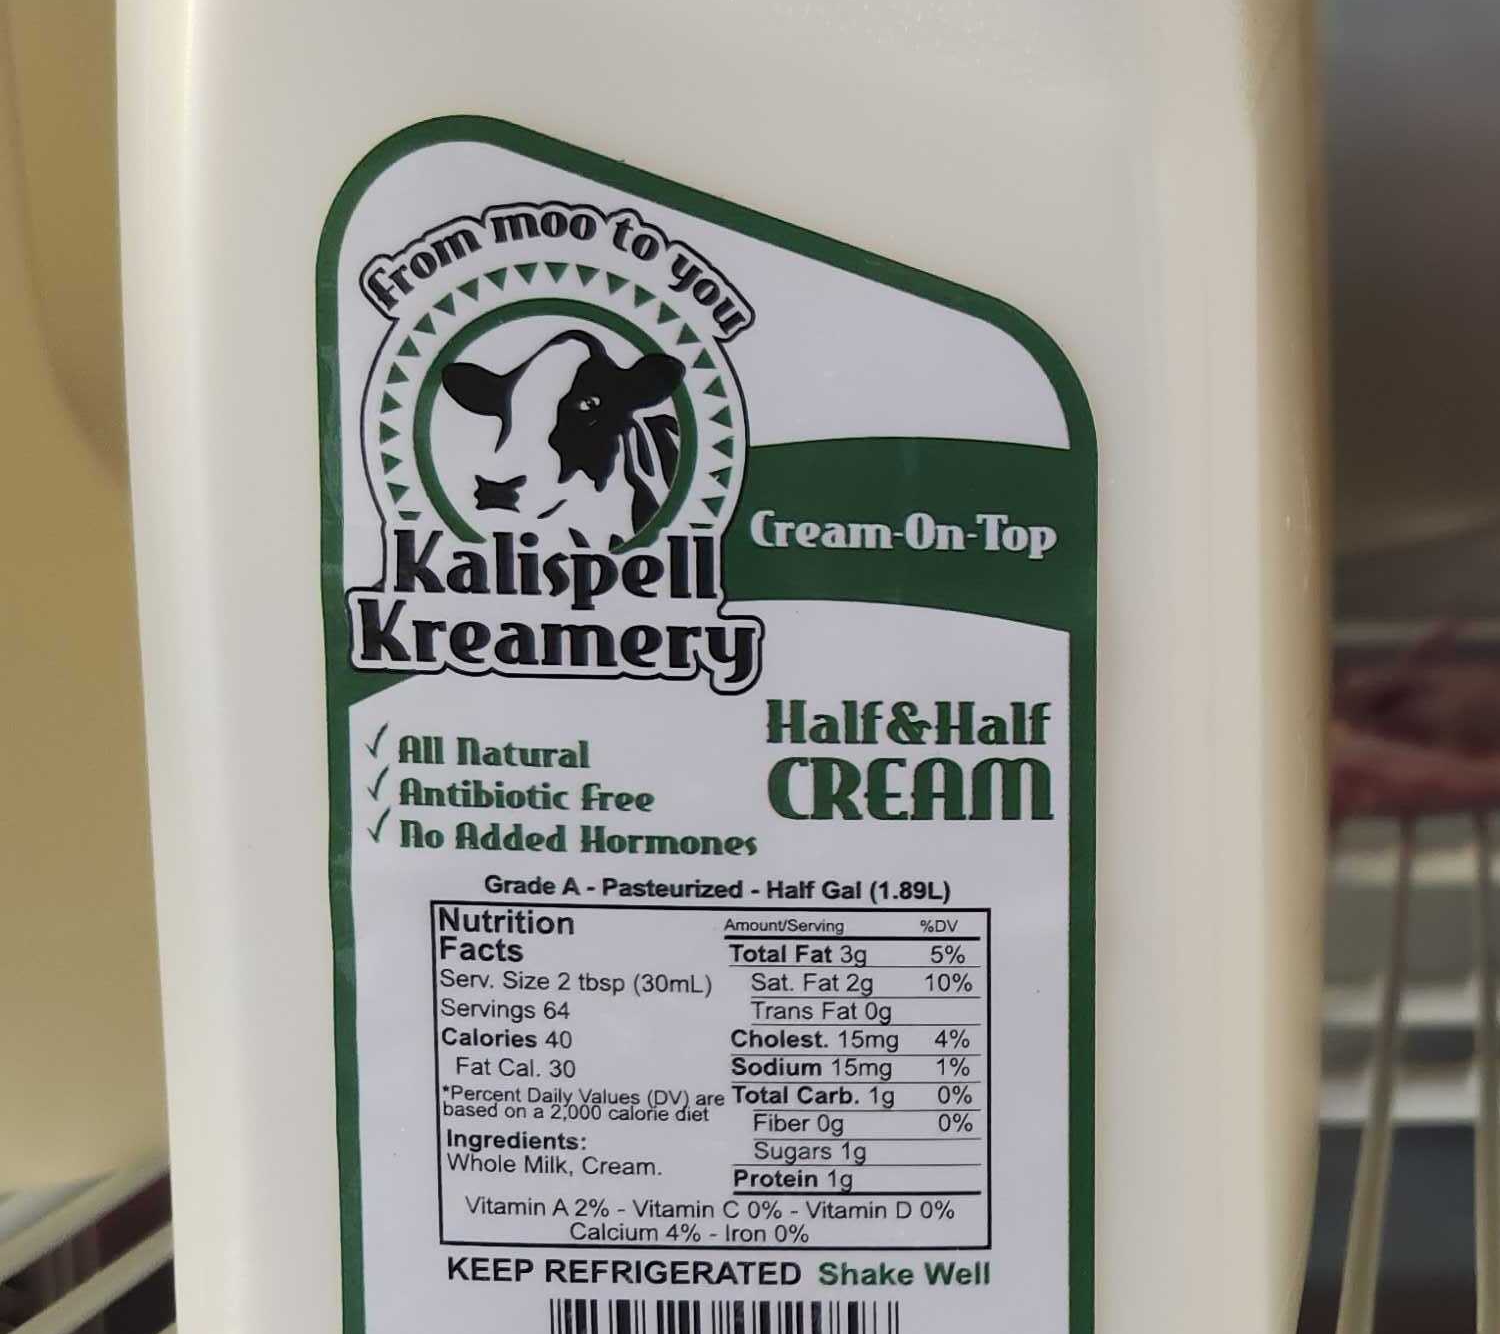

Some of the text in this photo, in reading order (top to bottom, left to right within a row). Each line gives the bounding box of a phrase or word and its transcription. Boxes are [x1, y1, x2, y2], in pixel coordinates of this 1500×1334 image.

[490, 211, 597, 243] moo
[612, 218, 660, 261] to
[668, 253, 748, 334] you
[750, 511, 1057, 559] Cream-On-Top
[394, 529, 717, 609] Kalispell
[358, 599, 756, 682] Kreamery
[766, 699, 1051, 746] Half&Half
[399, 735, 590, 769] All Natural
[399, 778, 569, 811] Antibiotic
[768, 757, 1054, 821] CREAM
[399, 820, 758, 857] No Added Hormones
[484, 874, 560, 896] Grade
[565, 877, 581, 896] A
[602, 877, 743, 900] Pasteurized
[766, 881, 814, 900] Half
[823, 881, 862, 900] Gal
[870, 881, 951, 904] (1.89L)
[439, 907, 574, 935] Nutrition
[440, 936, 524, 962] Facts
[440, 969, 712, 997] Serv. Size 2 tbsp (30mL)
[440, 999, 570, 1023] Servings 64
[442, 1027, 572, 1048] Calories 40
[456, 1057, 576, 1077] Fat Cal. 30
[443, 1102, 709, 1121] based on a 2,000 calorie diet
[528, 1088, 572, 1107] Daily
[579, 1089, 640, 1105] Values
[648, 1090, 689, 1110] (DV)
[696, 1094, 725, 1106] are
[448, 1129, 586, 1152] Ingredients:
[448, 1153, 662, 1176] Whole Milk, Cream.
[447, 1258, 990, 1285] KEEP REFRIGERATED Shake Well
